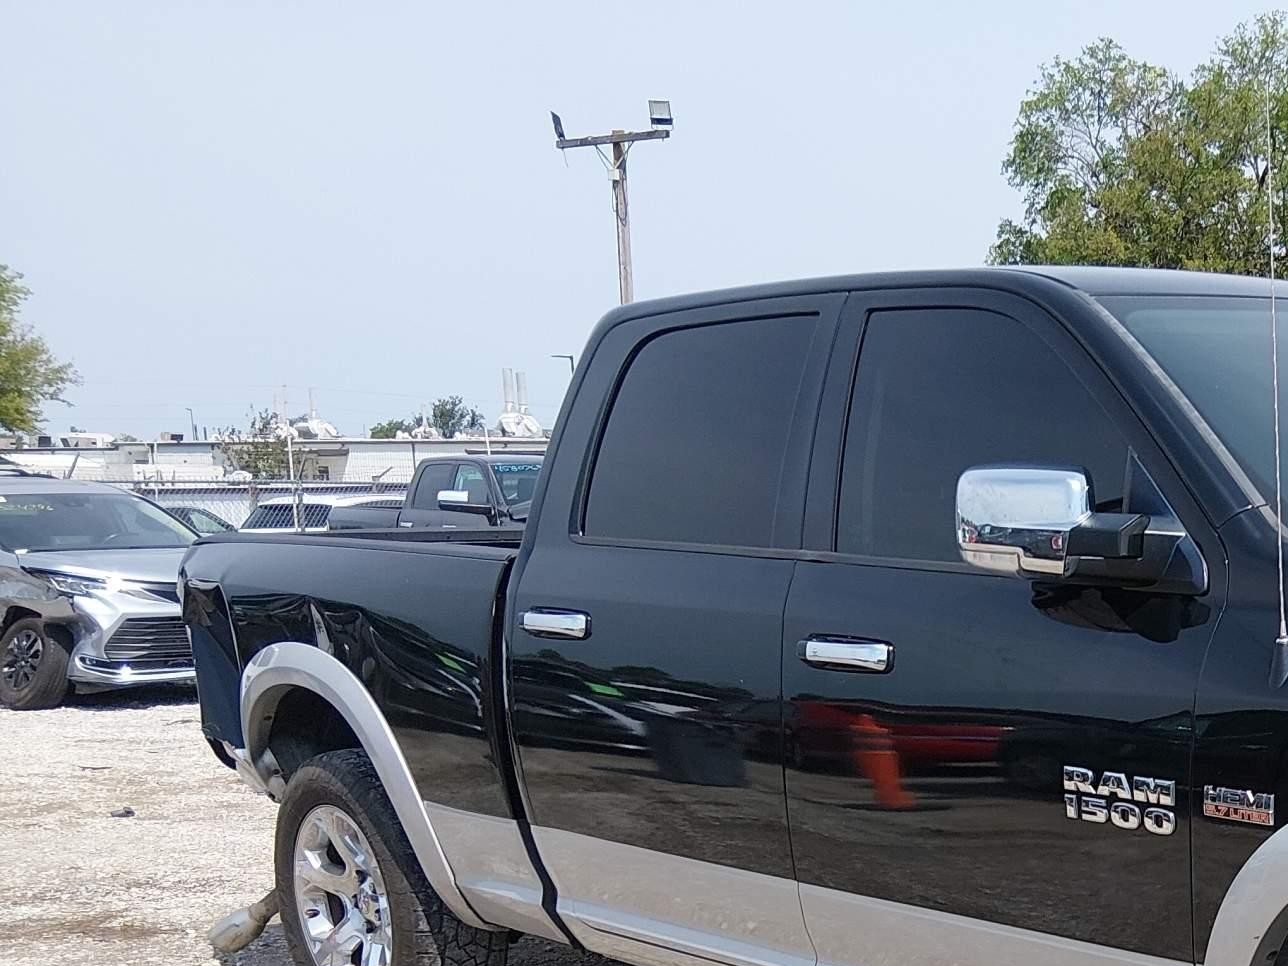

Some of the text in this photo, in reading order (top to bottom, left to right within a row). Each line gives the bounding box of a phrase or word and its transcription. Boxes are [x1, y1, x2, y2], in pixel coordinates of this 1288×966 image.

[1063, 765, 1176, 806] RAM
[1203, 785, 1274, 813] HEMI
[1063, 793, 1176, 836] 1500
[1205, 804, 1270, 824] 5.7 LITER
